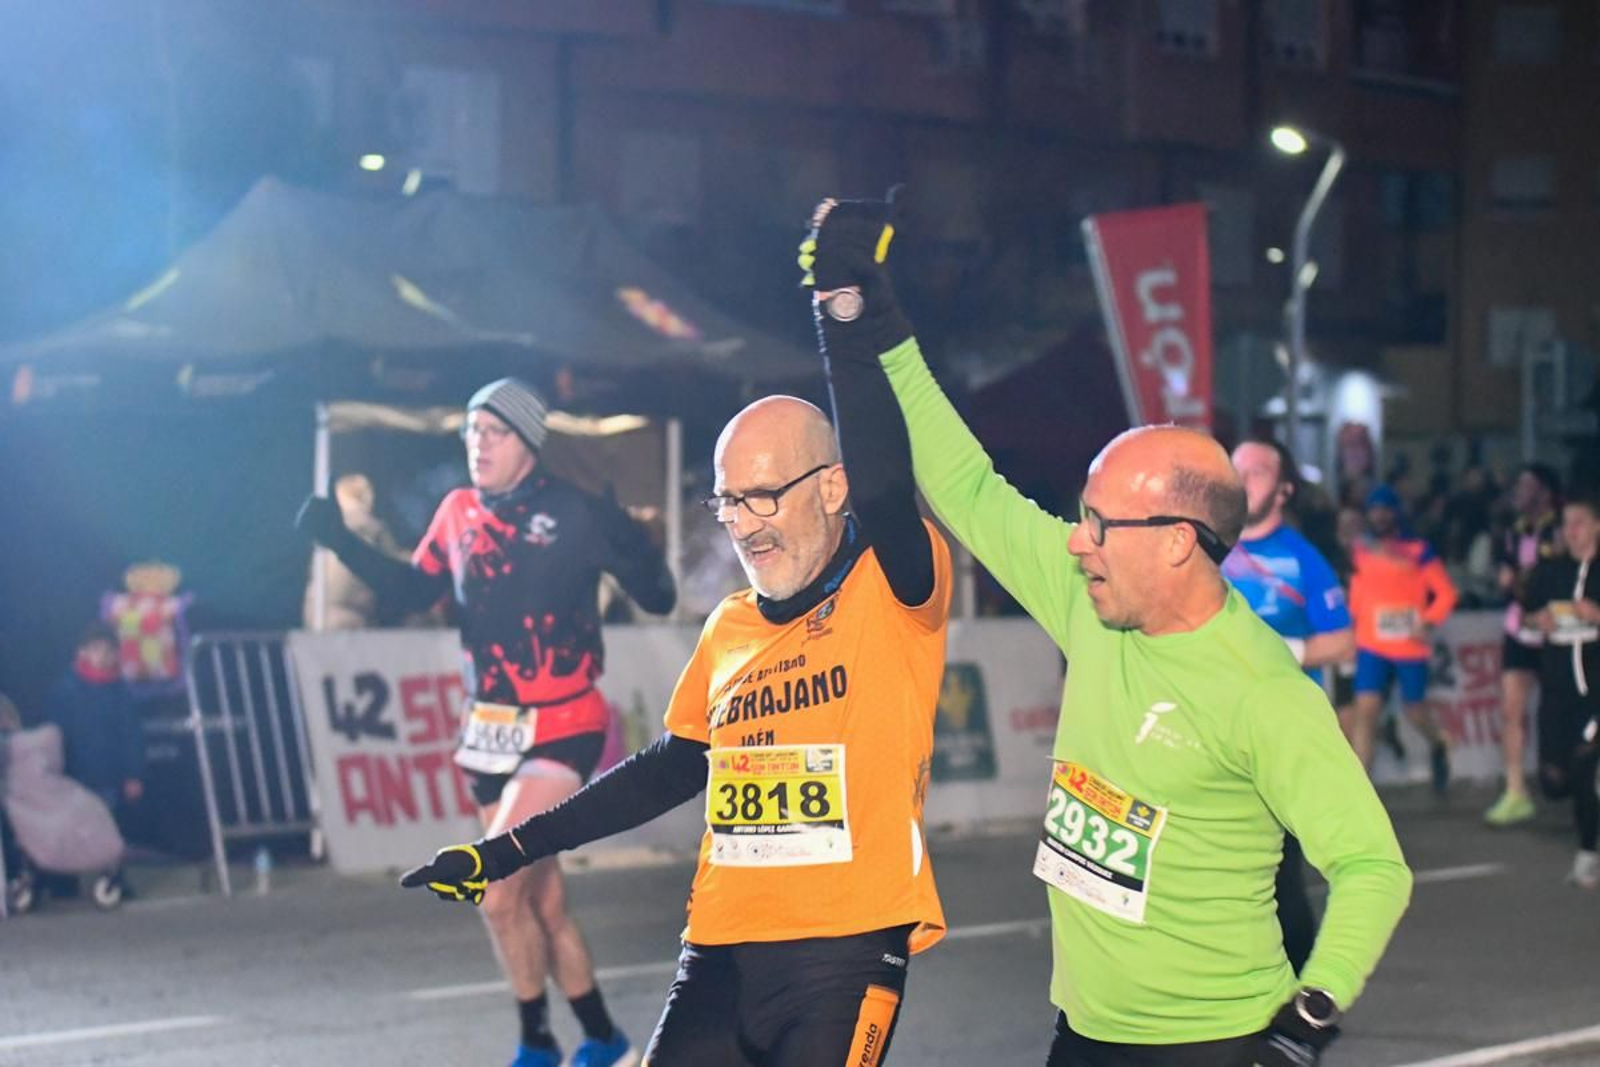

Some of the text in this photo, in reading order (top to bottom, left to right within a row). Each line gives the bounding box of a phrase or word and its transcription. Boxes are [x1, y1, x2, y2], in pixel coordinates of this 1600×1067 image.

[322, 670, 397, 742] 42
[707, 664, 847, 729] EBRAJANO
[731, 753, 751, 773] 42
[739, 729, 774, 746] JAÉN
[716, 780, 831, 821] 3818
[1044, 787, 1139, 876] 2932
